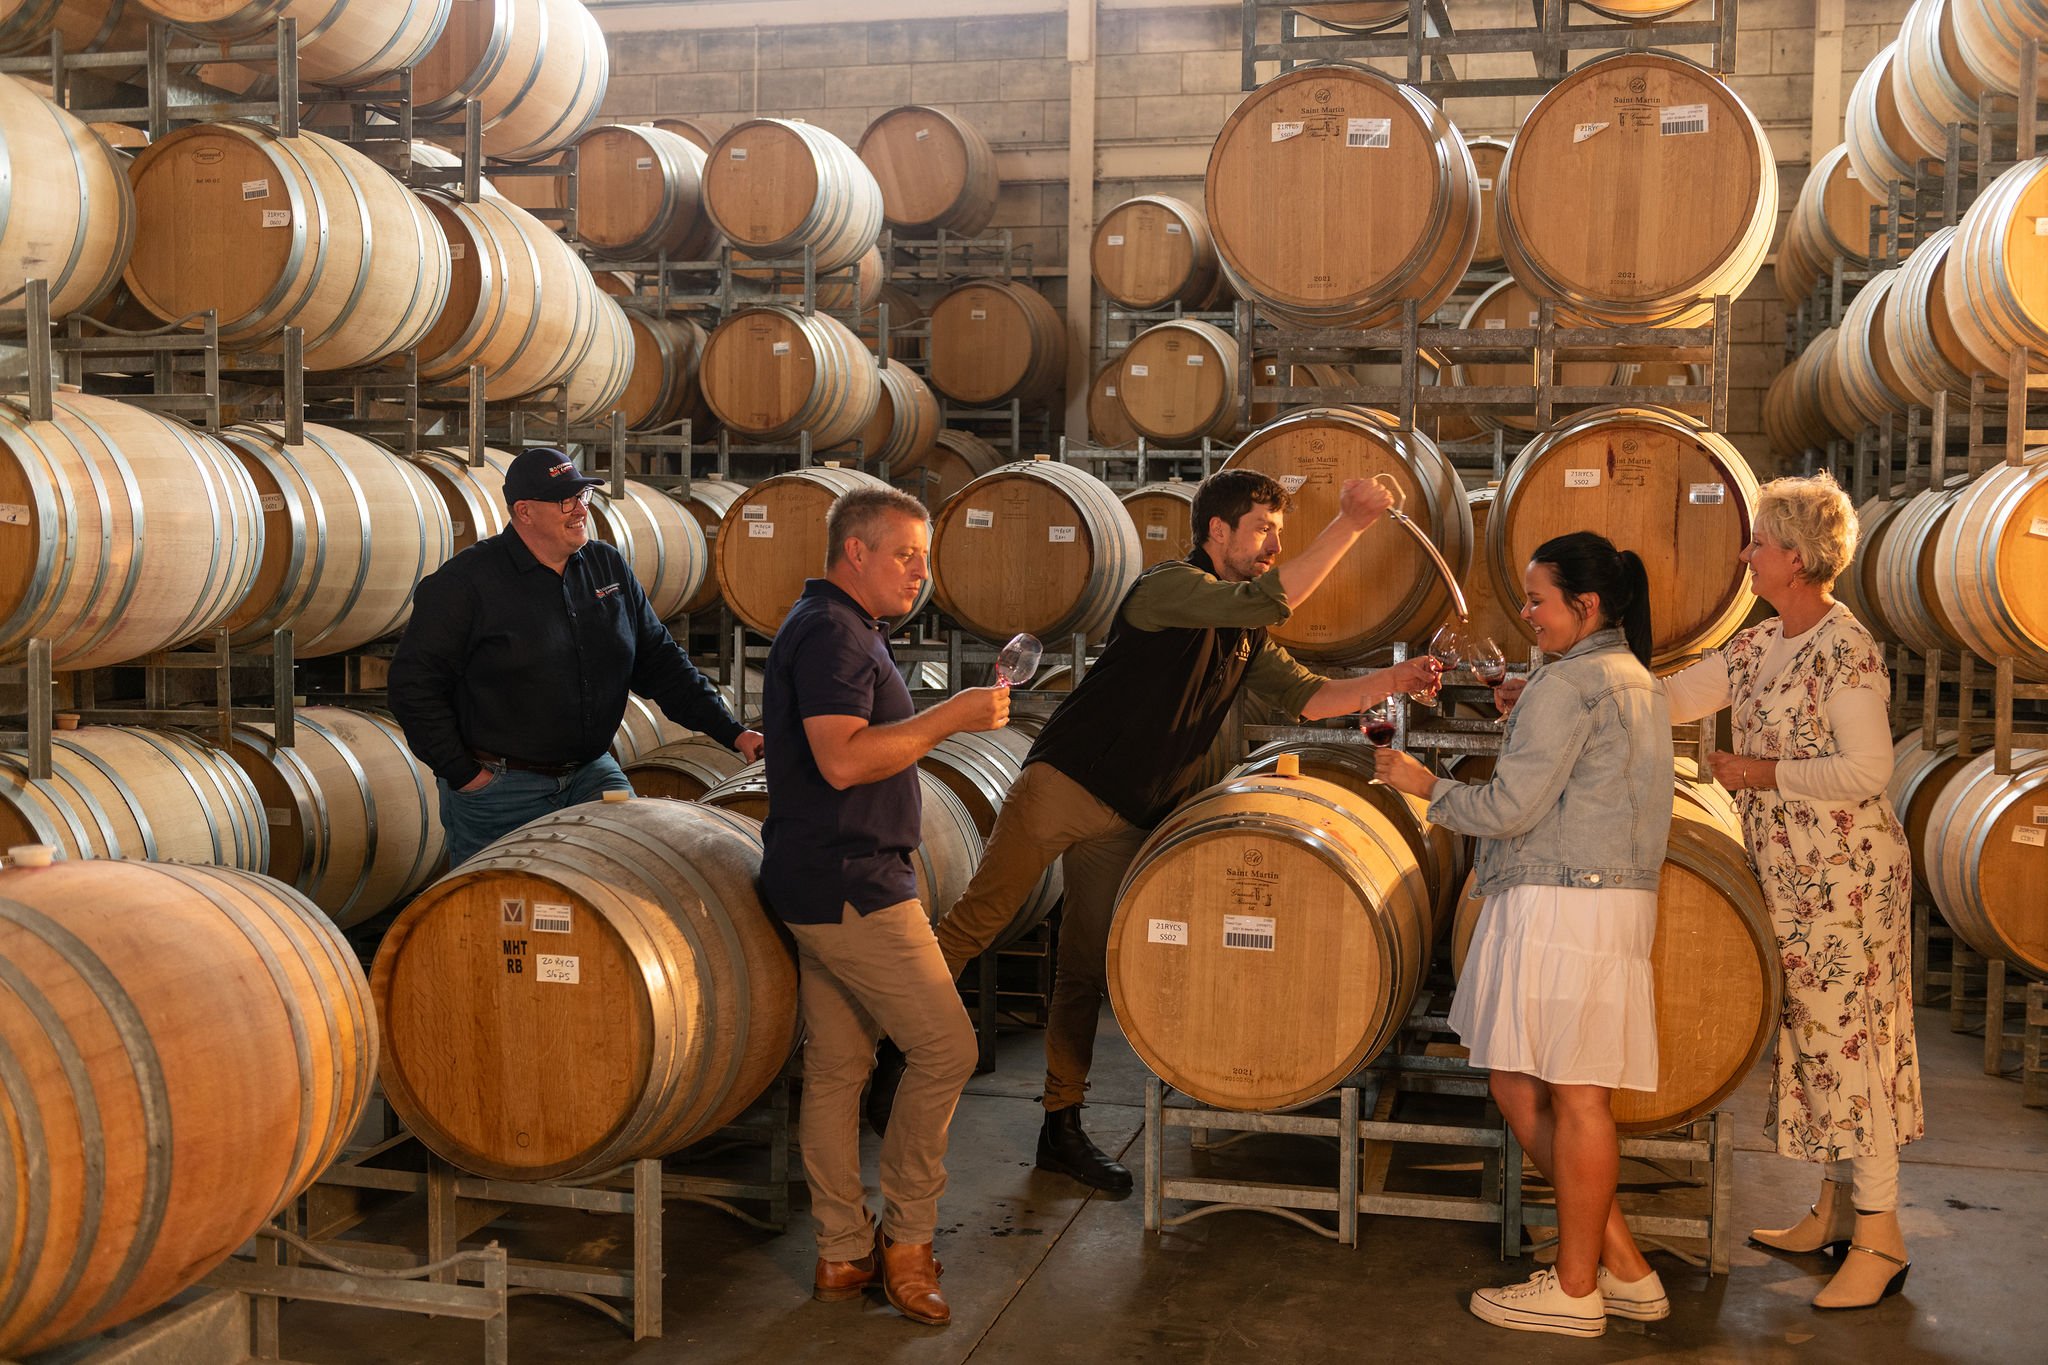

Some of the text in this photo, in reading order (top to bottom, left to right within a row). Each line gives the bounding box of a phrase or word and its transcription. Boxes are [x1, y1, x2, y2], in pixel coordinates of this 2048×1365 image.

[1227, 868, 1278, 879] Saint Martin
[1156, 922, 1181, 931] 21RYCS
[1160, 933, 1176, 941] SS02
[504, 941, 527, 954] MHT
[507, 959, 522, 973] RB
[1232, 1067, 1251, 1076] 2021
